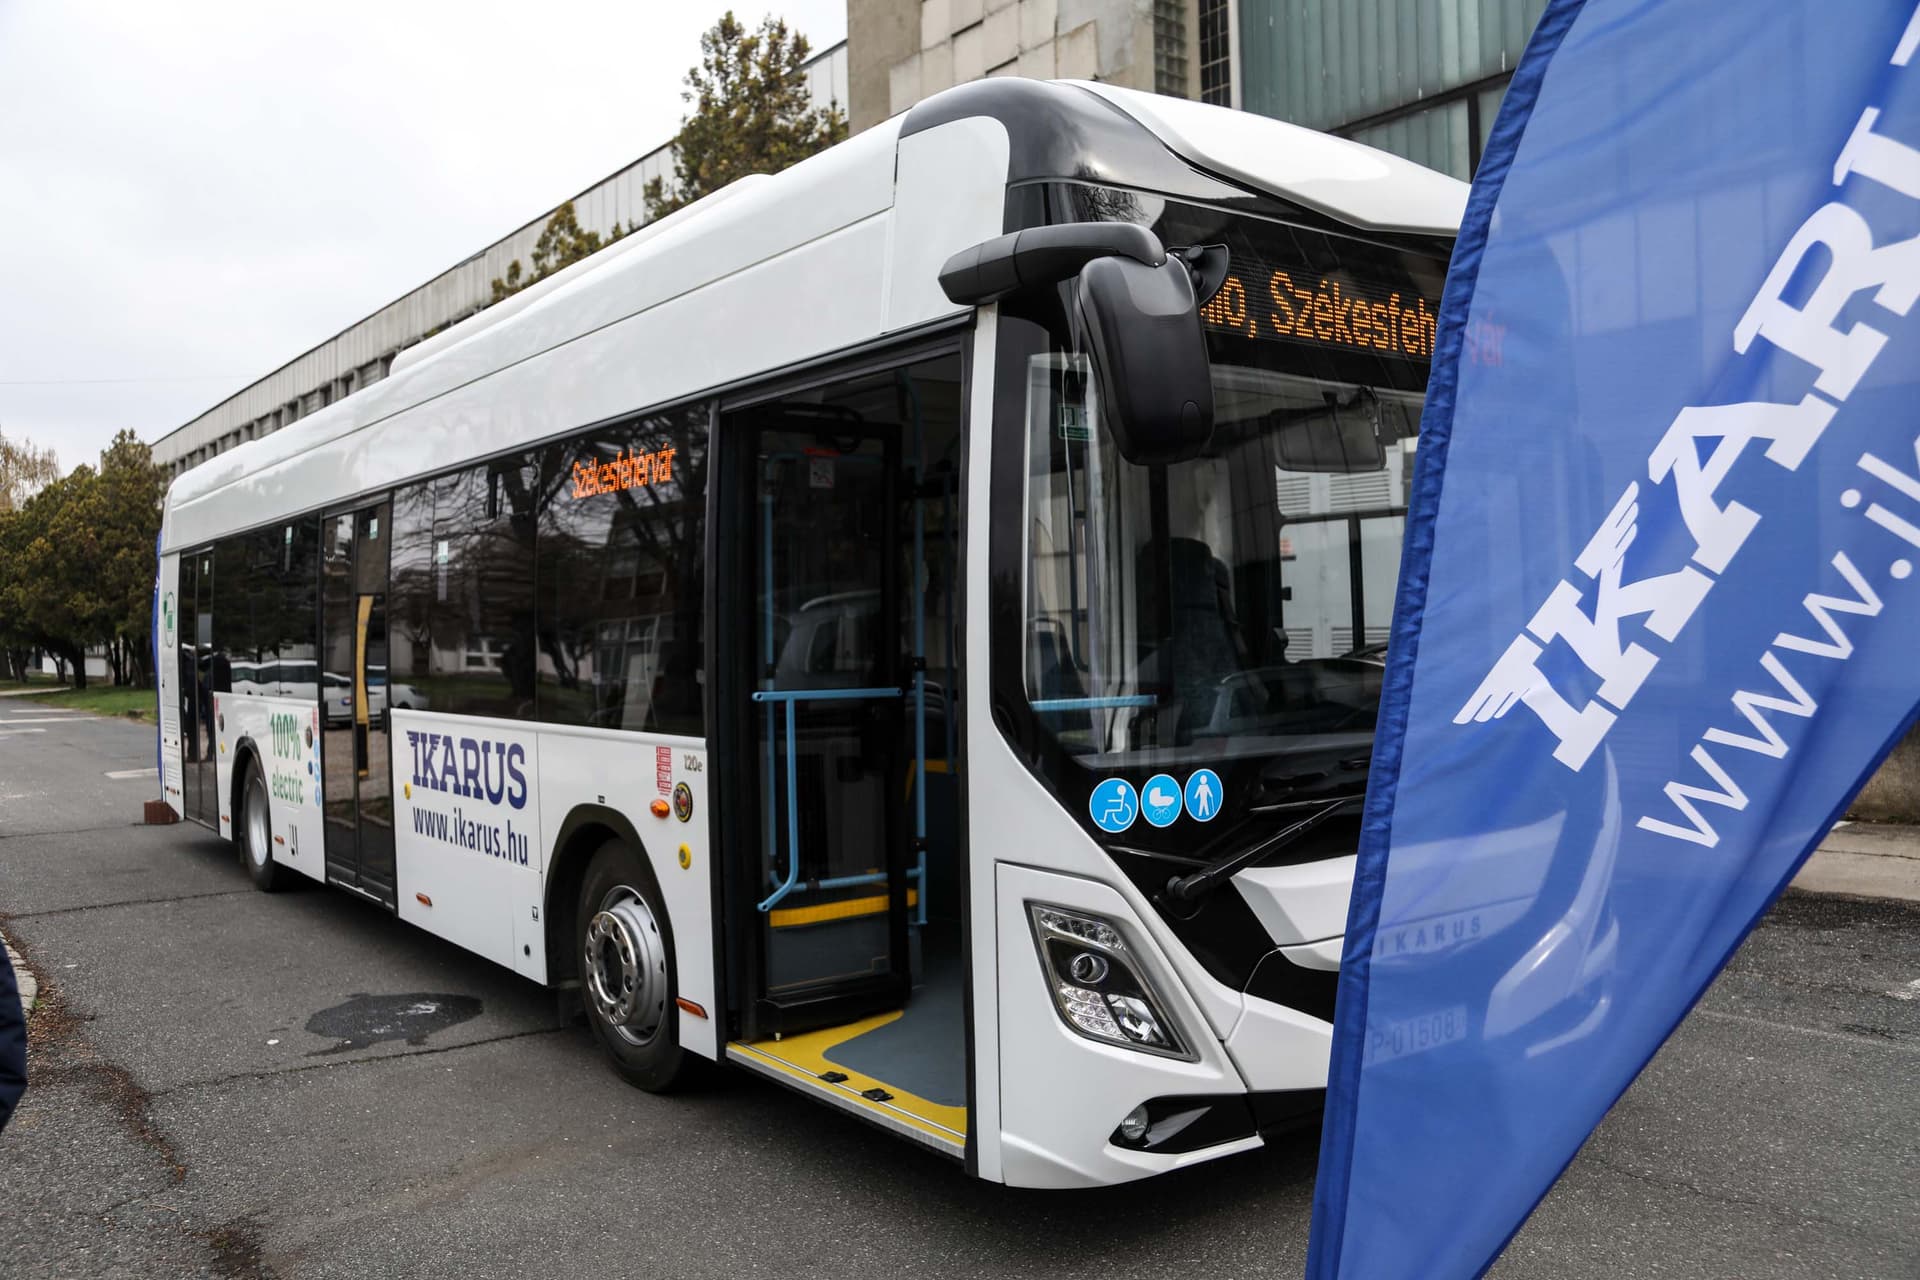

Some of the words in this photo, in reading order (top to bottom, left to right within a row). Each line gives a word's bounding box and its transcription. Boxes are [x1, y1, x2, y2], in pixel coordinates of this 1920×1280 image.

[573, 442, 677, 499] Székesfehérvár
[270, 713, 301, 761] 100%
[272, 764, 304, 805] electric
[406, 730, 528, 810] IKARUS
[683, 754, 703, 772] 120e
[412, 806, 529, 866] www.ikarus.hu
[1379, 914, 1481, 956] IKARUS
